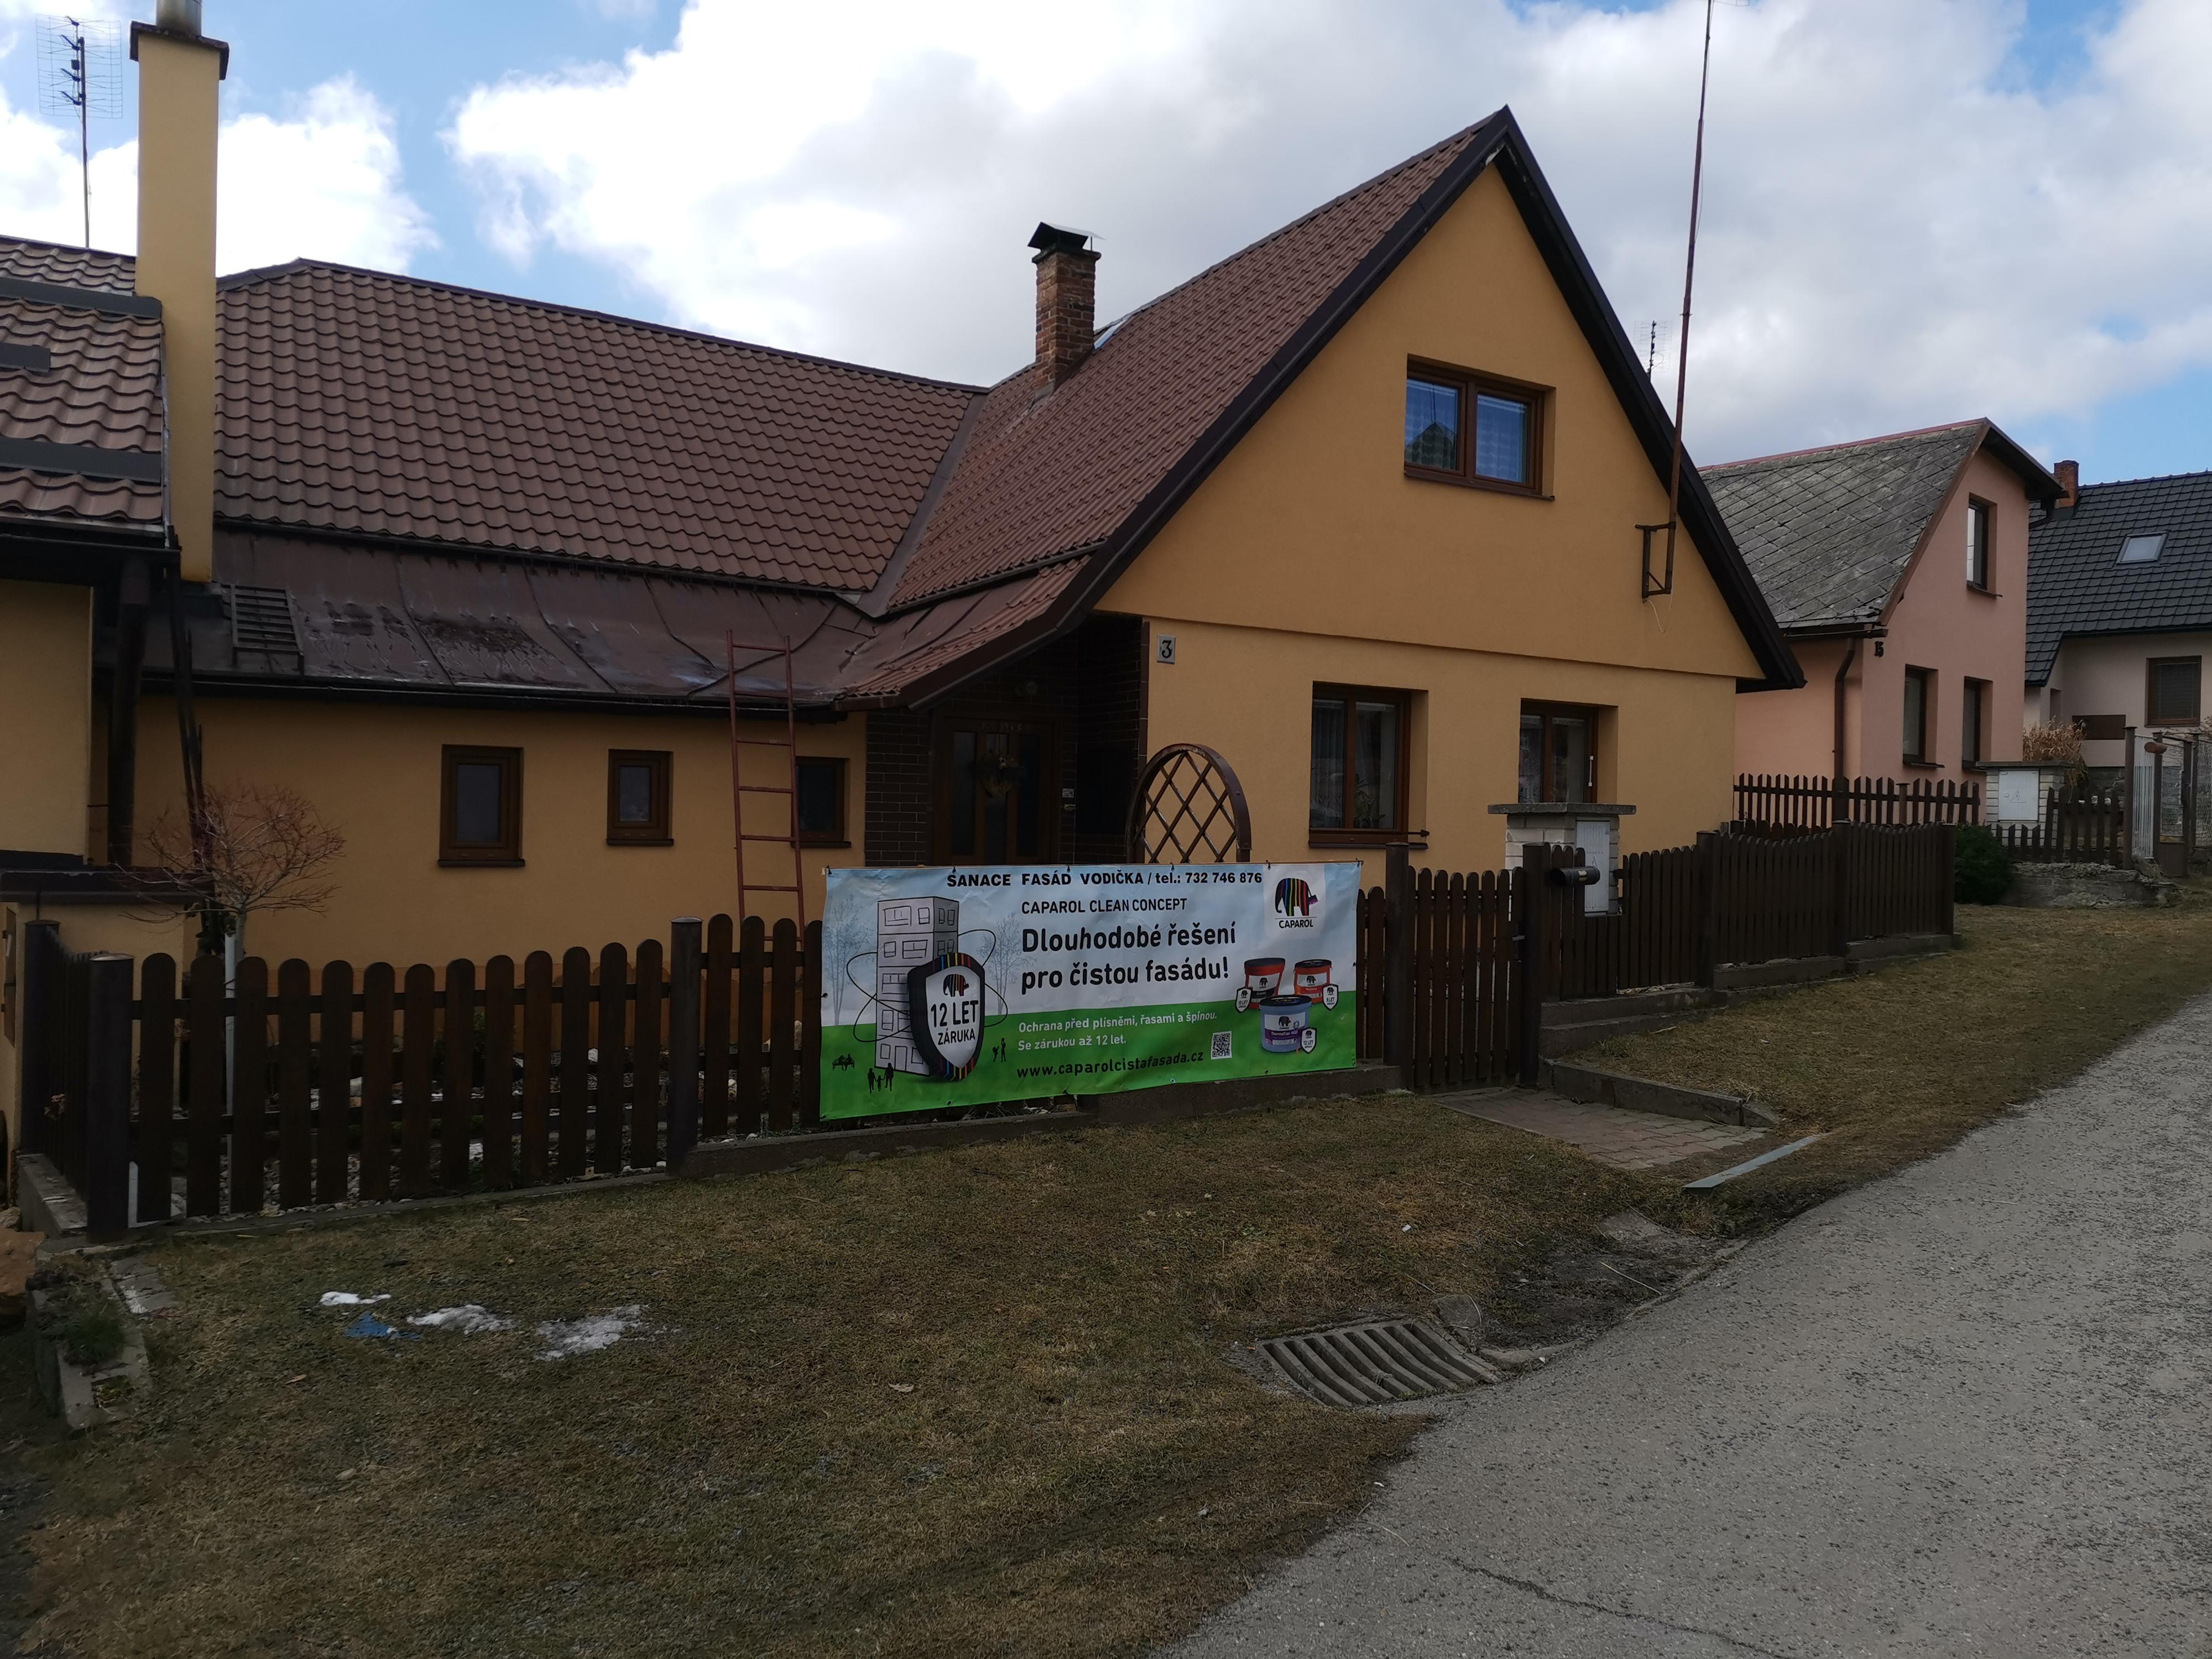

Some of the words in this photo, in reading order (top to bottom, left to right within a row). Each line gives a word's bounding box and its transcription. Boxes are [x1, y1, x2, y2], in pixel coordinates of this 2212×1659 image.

[1162, 640, 1172, 658] 3
[1874, 640, 1884, 657] 15
[947, 874, 1011, 887] SANACE
[1021, 870, 1072, 885] FASÁD
[1080, 869, 1144, 885] VODIČKA
[1147, 872, 1152, 885] /
[1155, 872, 1181, 884] tel.:
[1185, 872, 1208, 884] 732
[1212, 872, 1235, 884] 746
[1239, 872, 1262, 884] 876
[1021, 901, 1086, 914] CAPAROL
[1089, 899, 1129, 912] CLEAN
[1132, 898, 1187, 912] CONCEPT
[1279, 919, 1313, 929] CAPAROL
[1022, 924, 1162, 952] Dlouhodobé
[1168, 920, 1235, 947] řešení
[1021, 969, 1063, 995] pro
[1069, 961, 1139, 987] čistou
[1145, 956, 1229, 983] fasádu!
[930, 1003, 948, 1027] 12
[952, 1000, 979, 1025] LET
[1019, 1021, 1062, 1033] Ochrana
[1065, 1018, 1089, 1032] před
[1093, 1015, 1138, 1030] plísněmi,
[1140, 1013, 1175, 1025] řasami
[1177, 1015, 1183, 1023] a
[1186, 1010, 1217, 1024] špínou.
[937, 1027, 975, 1046] ZÁRUKA
[1018, 1040, 1032, 1051] Se
[1035, 1036, 1076, 1050] zárukou
[1079, 1035, 1093, 1046] až
[1097, 1035, 1108, 1045] 12
[1110, 1034, 1126, 1045] let.
[1017, 1051, 1204, 1078] www.caparolcistafasada.cz
